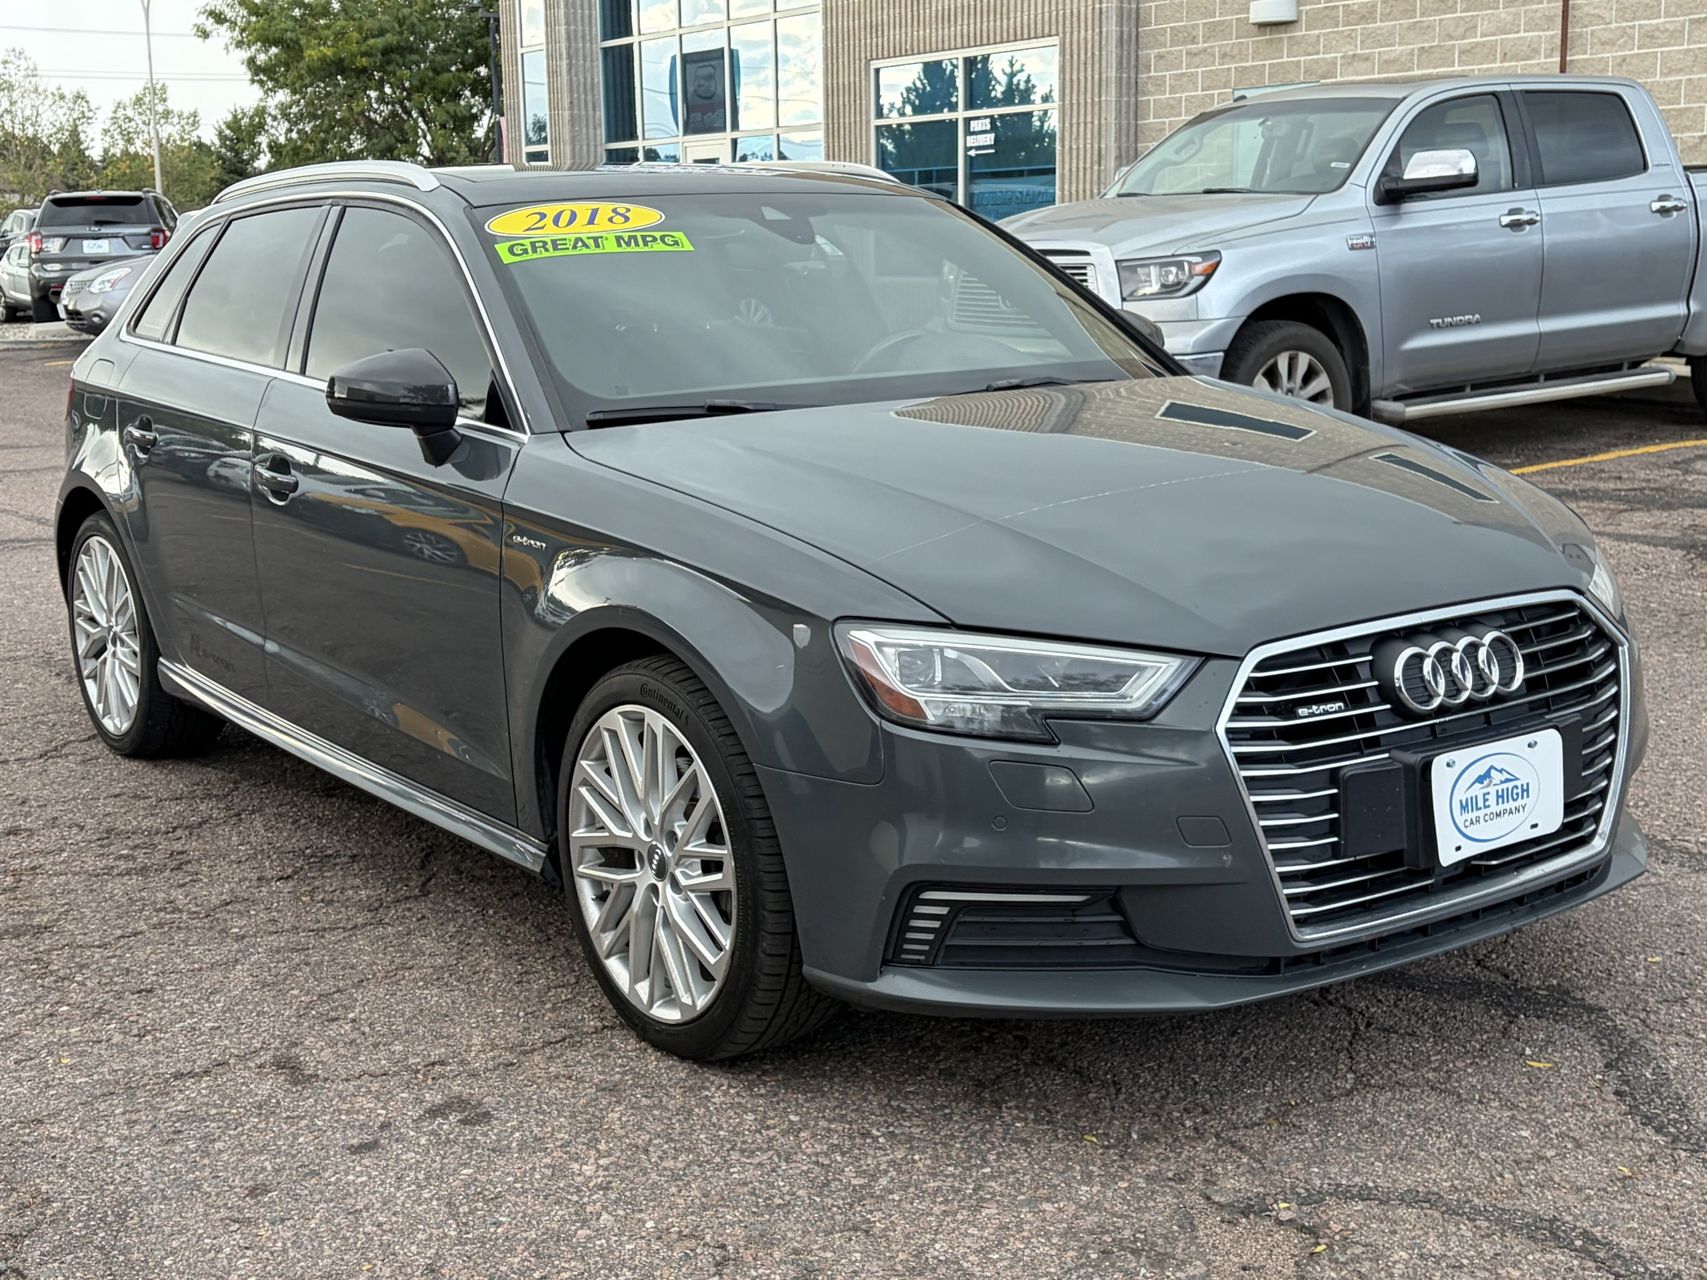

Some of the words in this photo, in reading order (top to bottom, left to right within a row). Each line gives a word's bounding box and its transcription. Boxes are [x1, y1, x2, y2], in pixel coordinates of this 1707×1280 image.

[523, 206, 631, 232] 2018
[507, 236, 604, 257] GREAT
[616, 234, 683, 249] MPG
[1430, 314, 1481, 328] TUNDRA
[512, 535, 547, 550] e-tron
[640, 683, 685, 720] Continental
[1298, 702, 1344, 716] e-tron
[1459, 792, 1491, 816] MILE
[1496, 782, 1530, 806] HIGH
[1463, 816, 1481, 829] CAR
[1483, 803, 1527, 823] COMPANY
